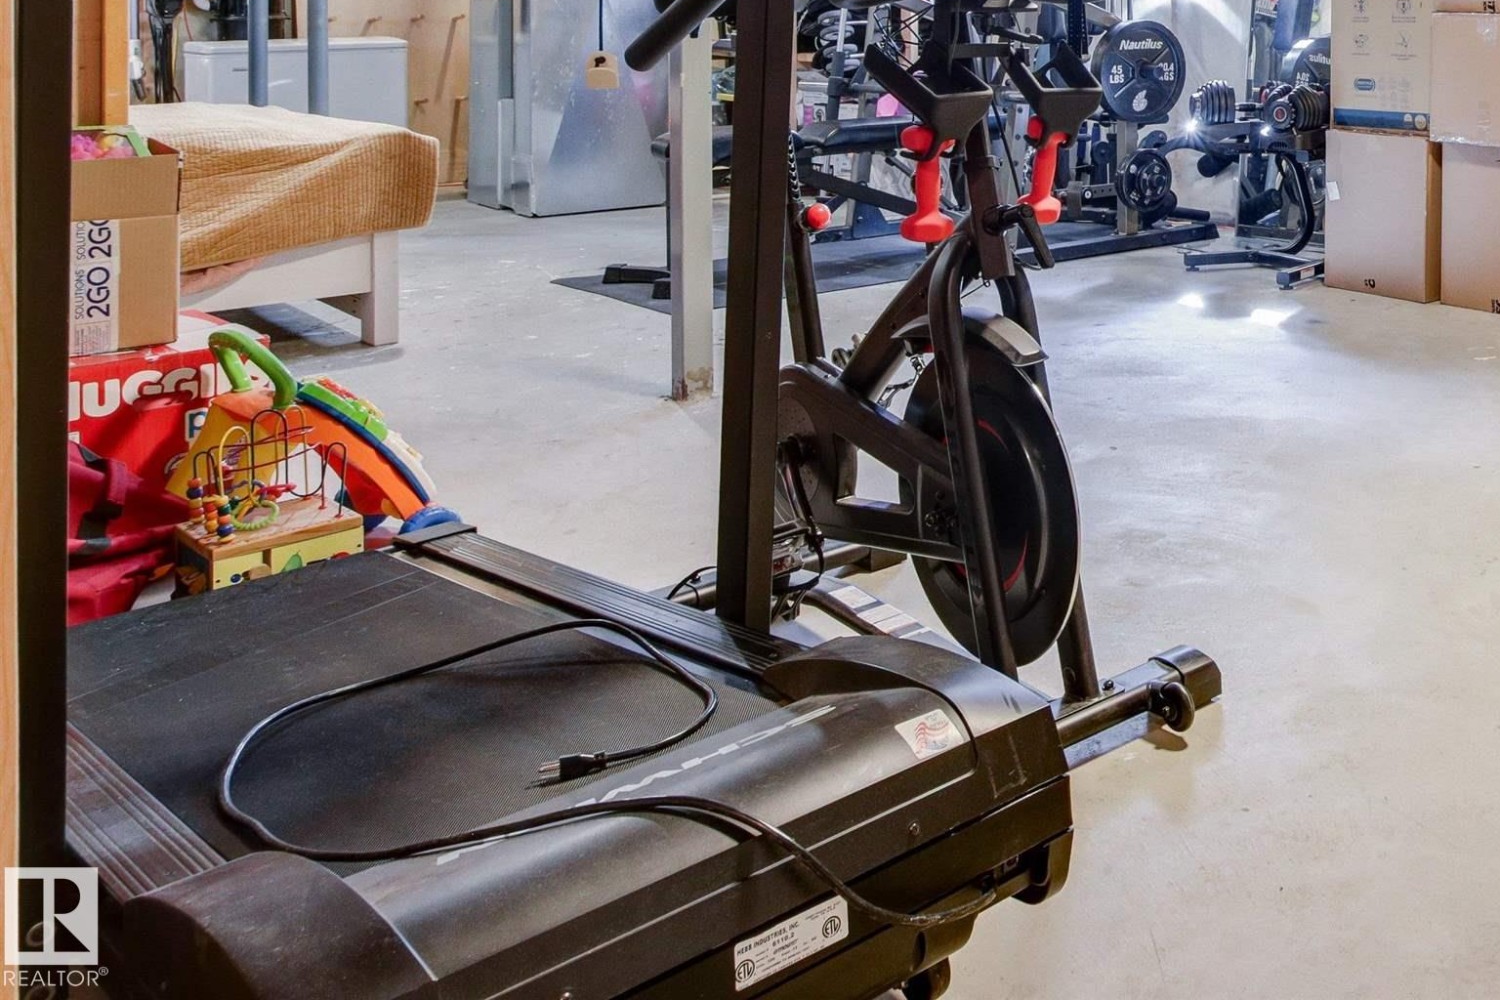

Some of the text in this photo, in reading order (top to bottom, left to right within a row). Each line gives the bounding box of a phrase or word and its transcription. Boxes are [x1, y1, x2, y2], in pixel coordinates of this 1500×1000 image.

[1119, 39, 1163, 50] Nautilus
[1111, 65, 1123, 74] 45
[1109, 75, 1124, 84] LBS
[75, 268, 85, 320] SOLUTIONS
[86, 266, 111, 318] 2GO
